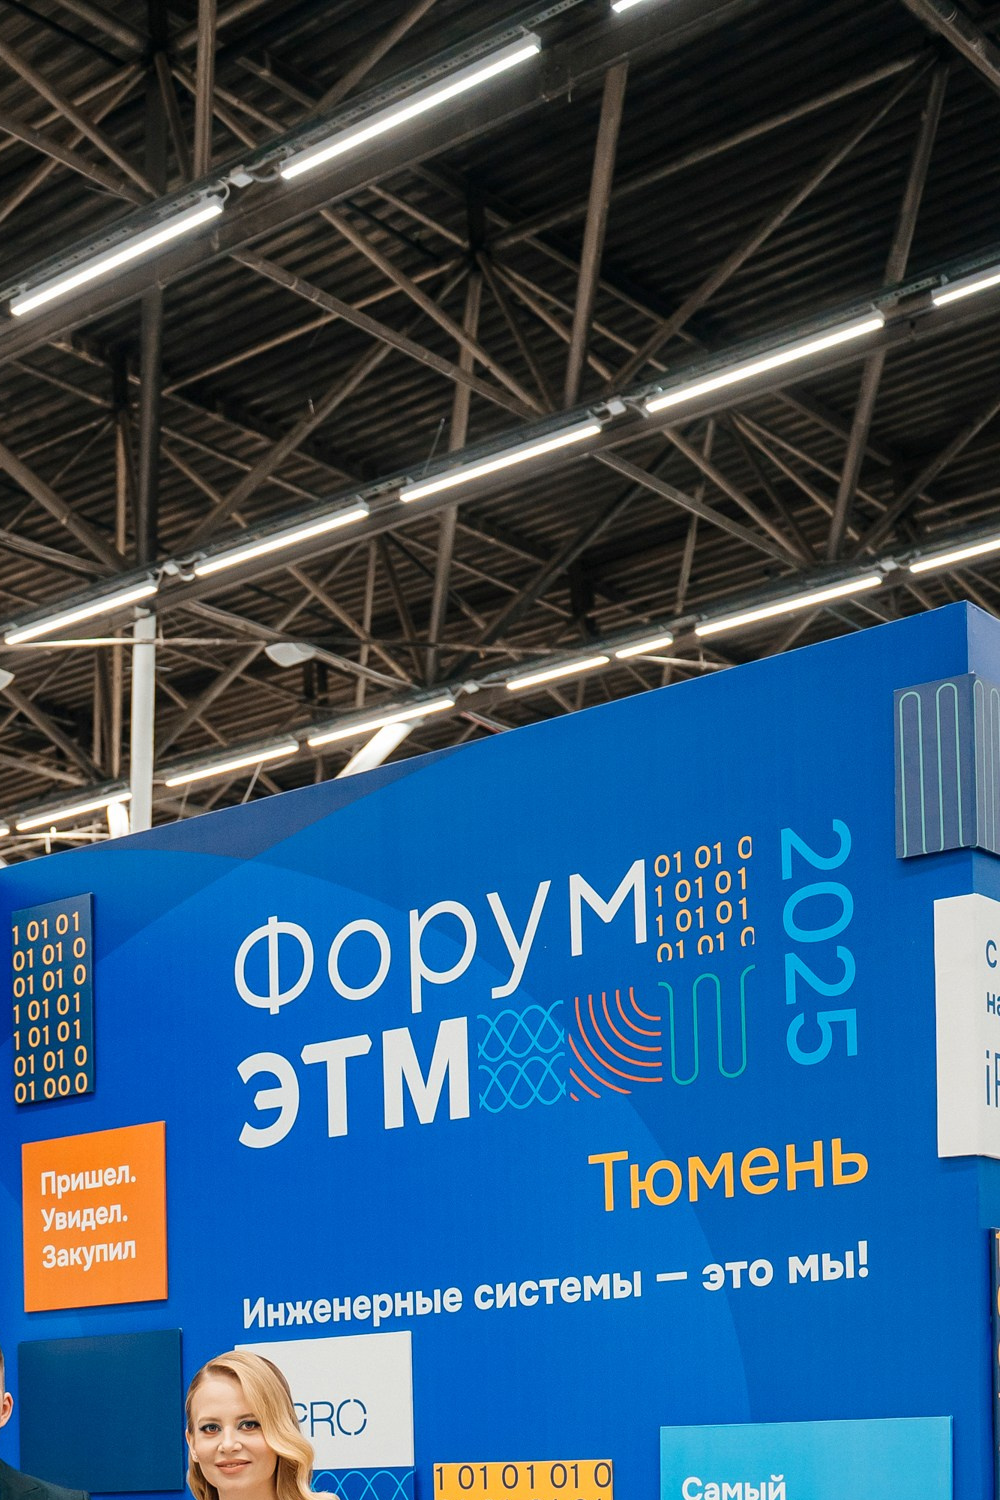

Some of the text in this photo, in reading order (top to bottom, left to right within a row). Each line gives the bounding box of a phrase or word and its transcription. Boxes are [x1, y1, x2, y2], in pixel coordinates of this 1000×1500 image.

[235, 860, 646, 1014] Форум
[781, 820, 857, 1065] 2025
[237, 1017, 469, 1148] ЭТМ
[41, 1166, 136, 1198] Пришел.
[589, 1138, 868, 1211] Тюмень
[41, 1205, 127, 1231] Увидел.
[42, 1240, 136, 1271] Закупил
[243, 1288, 462, 1328] Инженерные
[475, 1270, 641, 1309] системы
[703, 1259, 773, 1290] это
[789, 1241, 868, 1283] мы!
[294, 1399, 367, 1437] PRO
